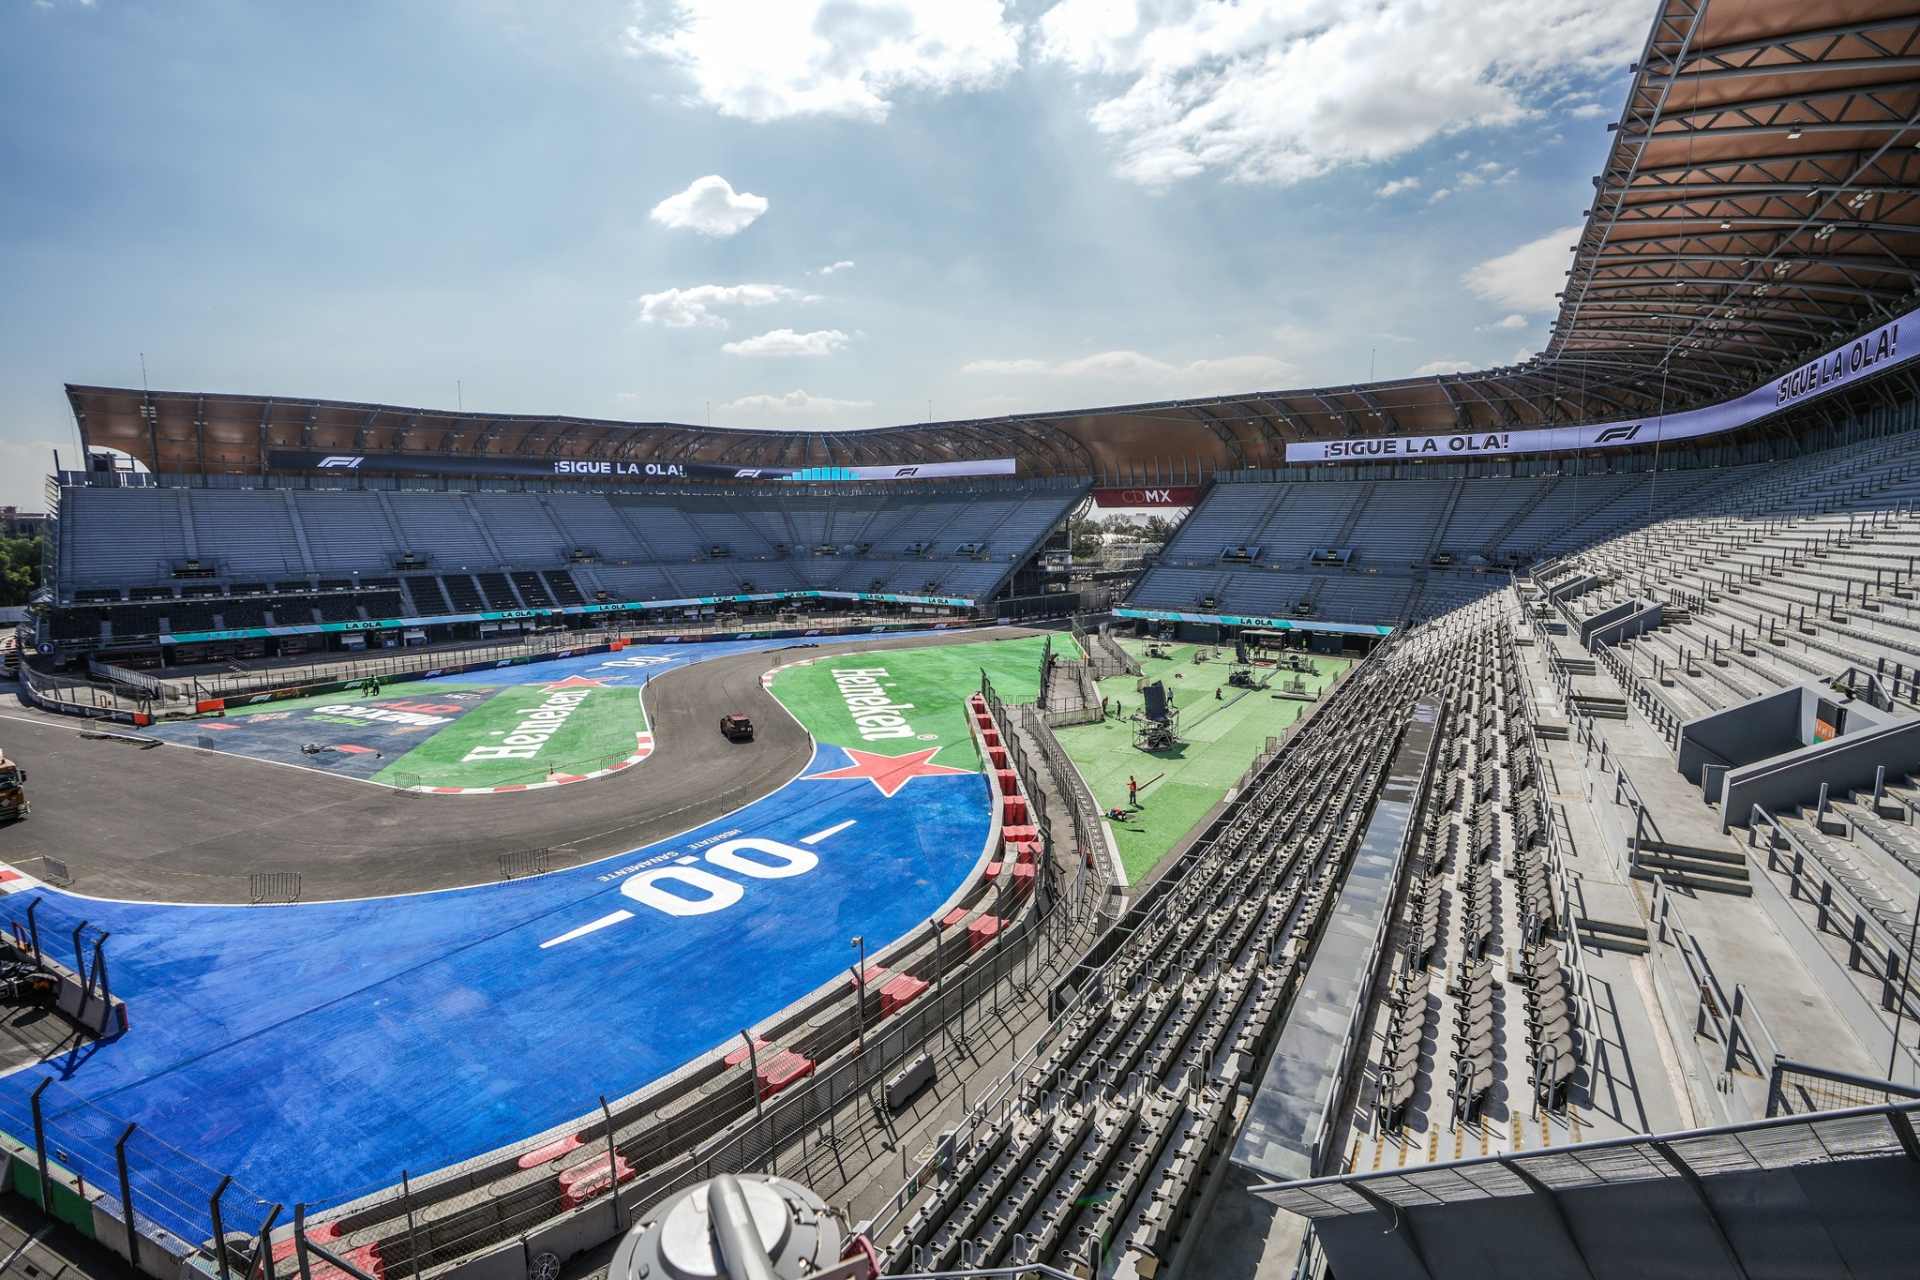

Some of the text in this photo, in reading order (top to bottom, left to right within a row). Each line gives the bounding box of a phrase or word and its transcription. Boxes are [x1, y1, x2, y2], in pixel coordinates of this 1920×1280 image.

[1822, 351, 1843, 384] LA
[1850, 324, 1898, 373] OLA!
[554, 461, 684, 477] ¡SIGUE LA OLA!
[1324, 434, 1509, 458] ¡SIGUE LA OLA!
[461, 689, 592, 762] Heineken
[831, 667, 916, 741] Heineken
